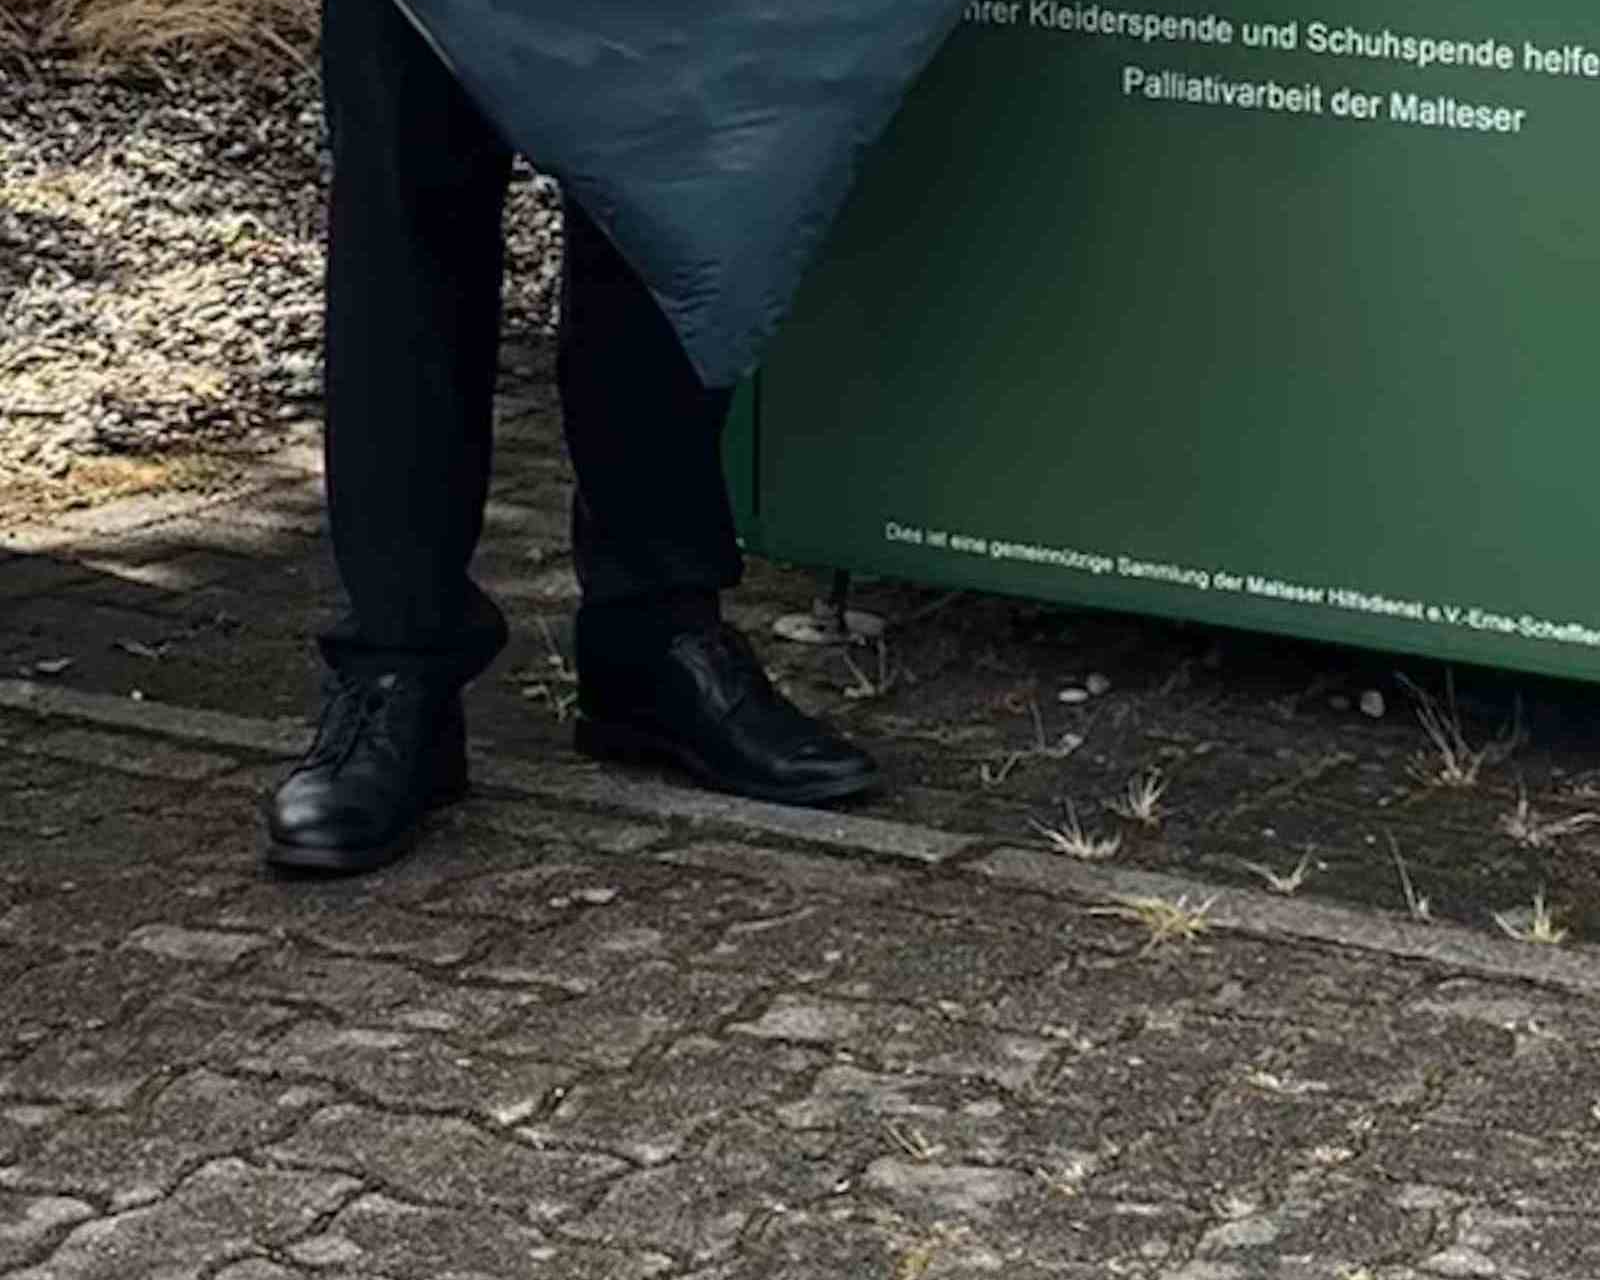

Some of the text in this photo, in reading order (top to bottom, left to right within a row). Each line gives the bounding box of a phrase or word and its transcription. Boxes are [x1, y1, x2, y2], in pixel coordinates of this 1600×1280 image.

[1242, 21, 1298, 50] und
[1305, 23, 1514, 70] Schuhspende
[1122, 65, 1527, 133] Palliativarbeit der Malteser
[950, 534, 987, 554] eine
[1117, 556, 1209, 591] Sammlung
[1212, 570, 1243, 591] der
[1246, 574, 1324, 604] Malteser
